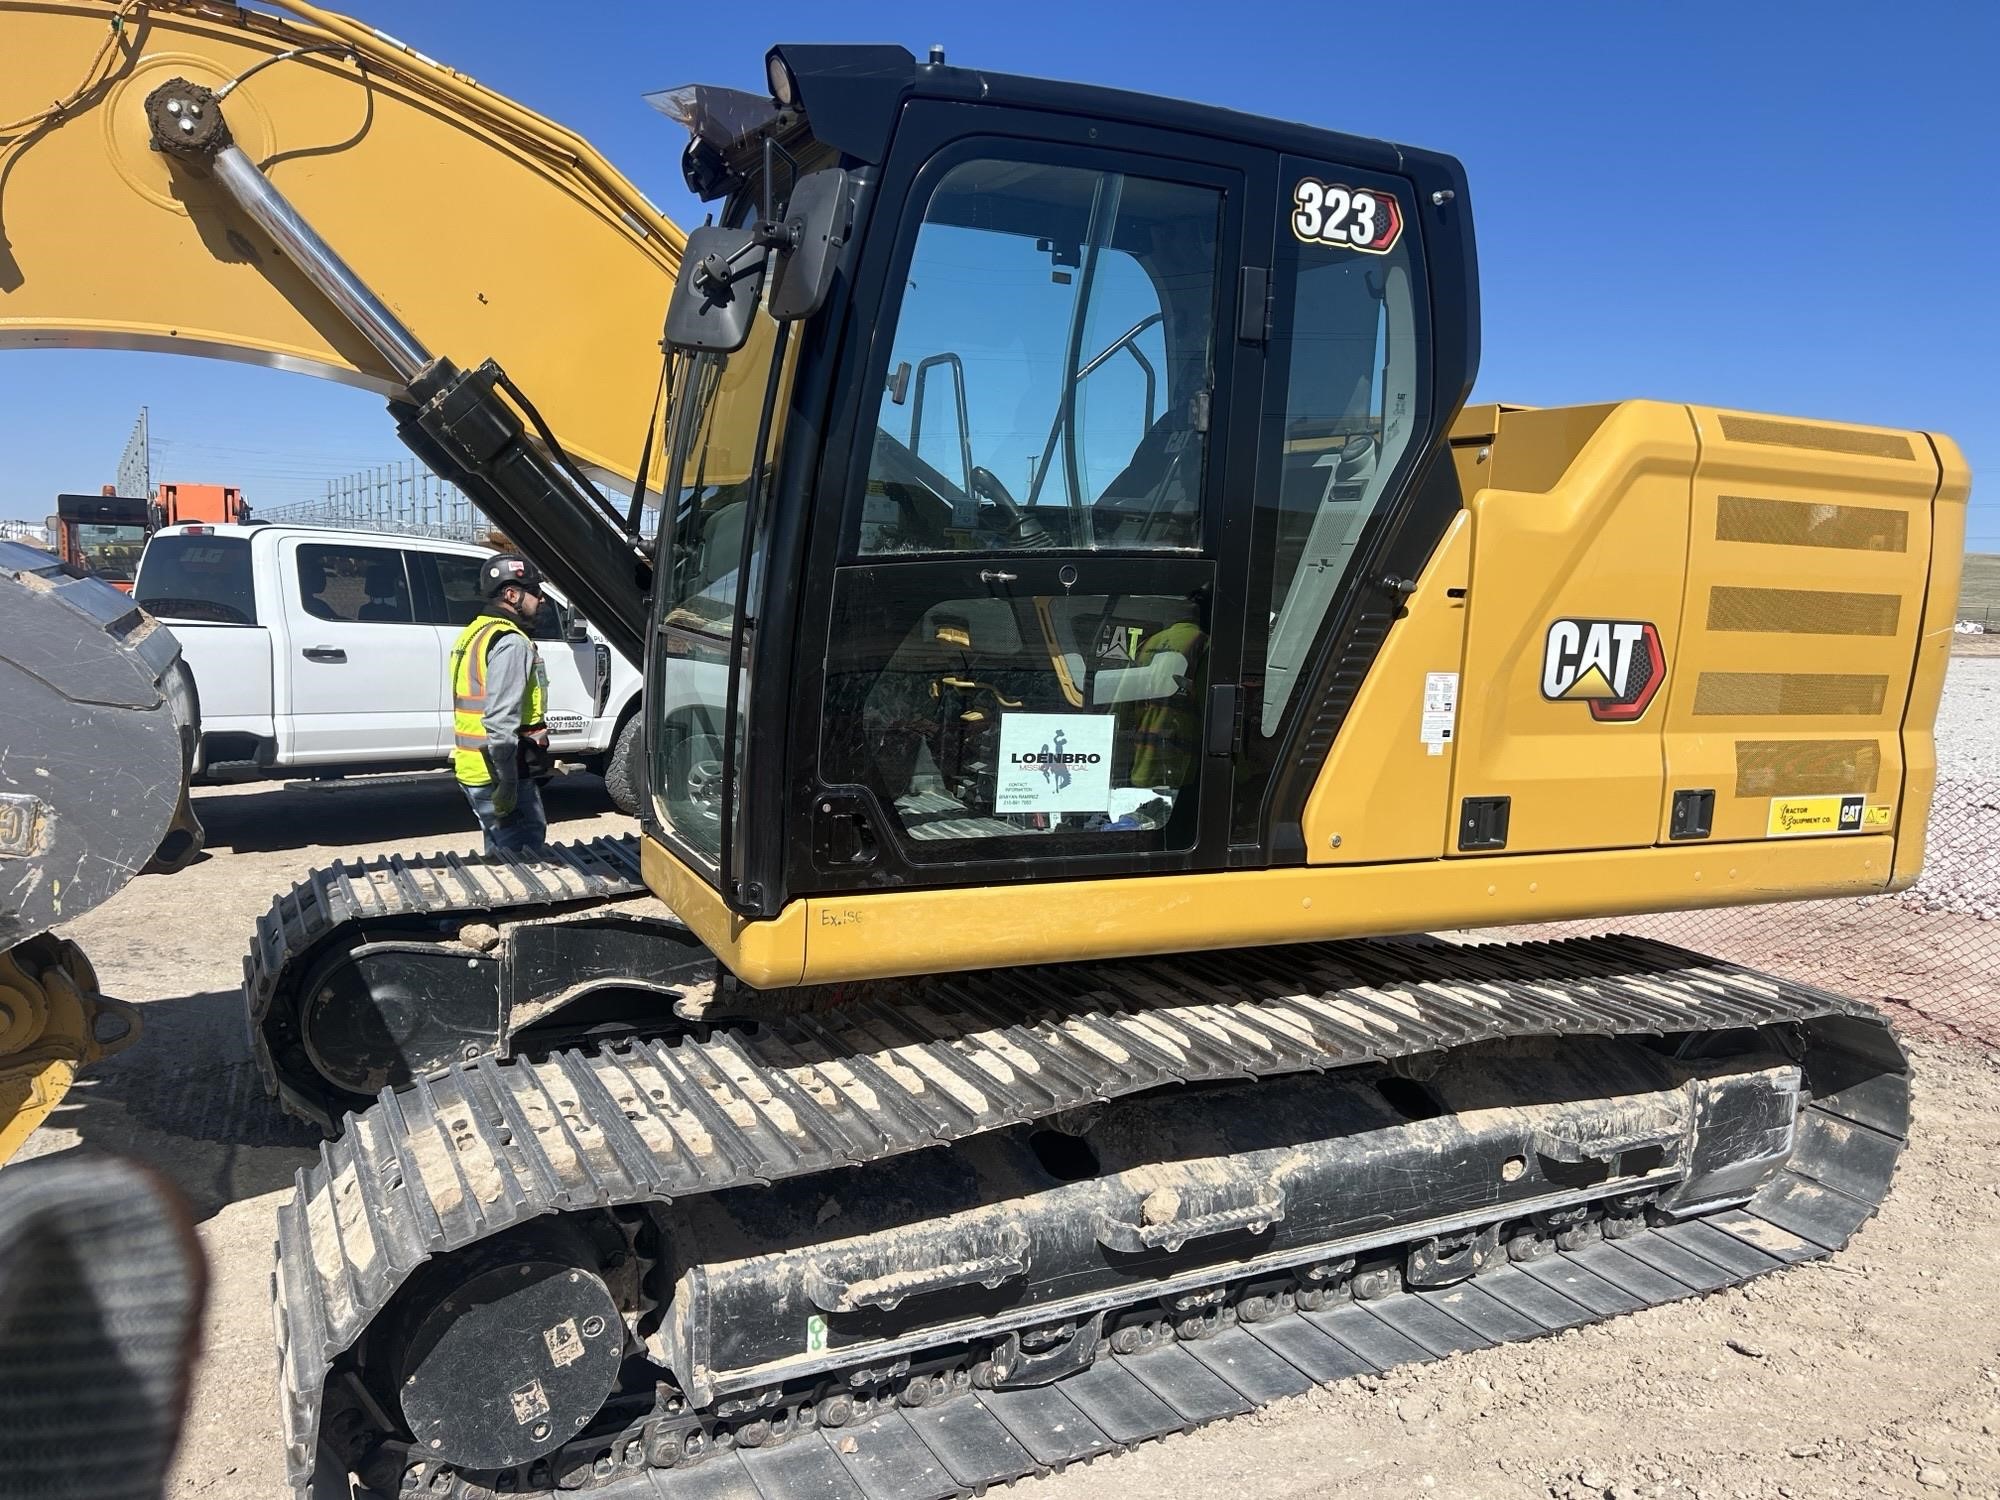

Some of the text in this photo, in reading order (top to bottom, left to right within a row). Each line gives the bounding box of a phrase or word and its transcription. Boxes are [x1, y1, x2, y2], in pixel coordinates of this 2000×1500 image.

[1296, 181, 1376, 245] 323
[1096, 625, 1143, 661] CAT
[1543, 620, 1643, 698] CAT
[1011, 753, 1101, 764] LOENBRO
[1785, 815, 1821, 831] EQUIPMENT
[1841, 805, 1862, 823] CAT
